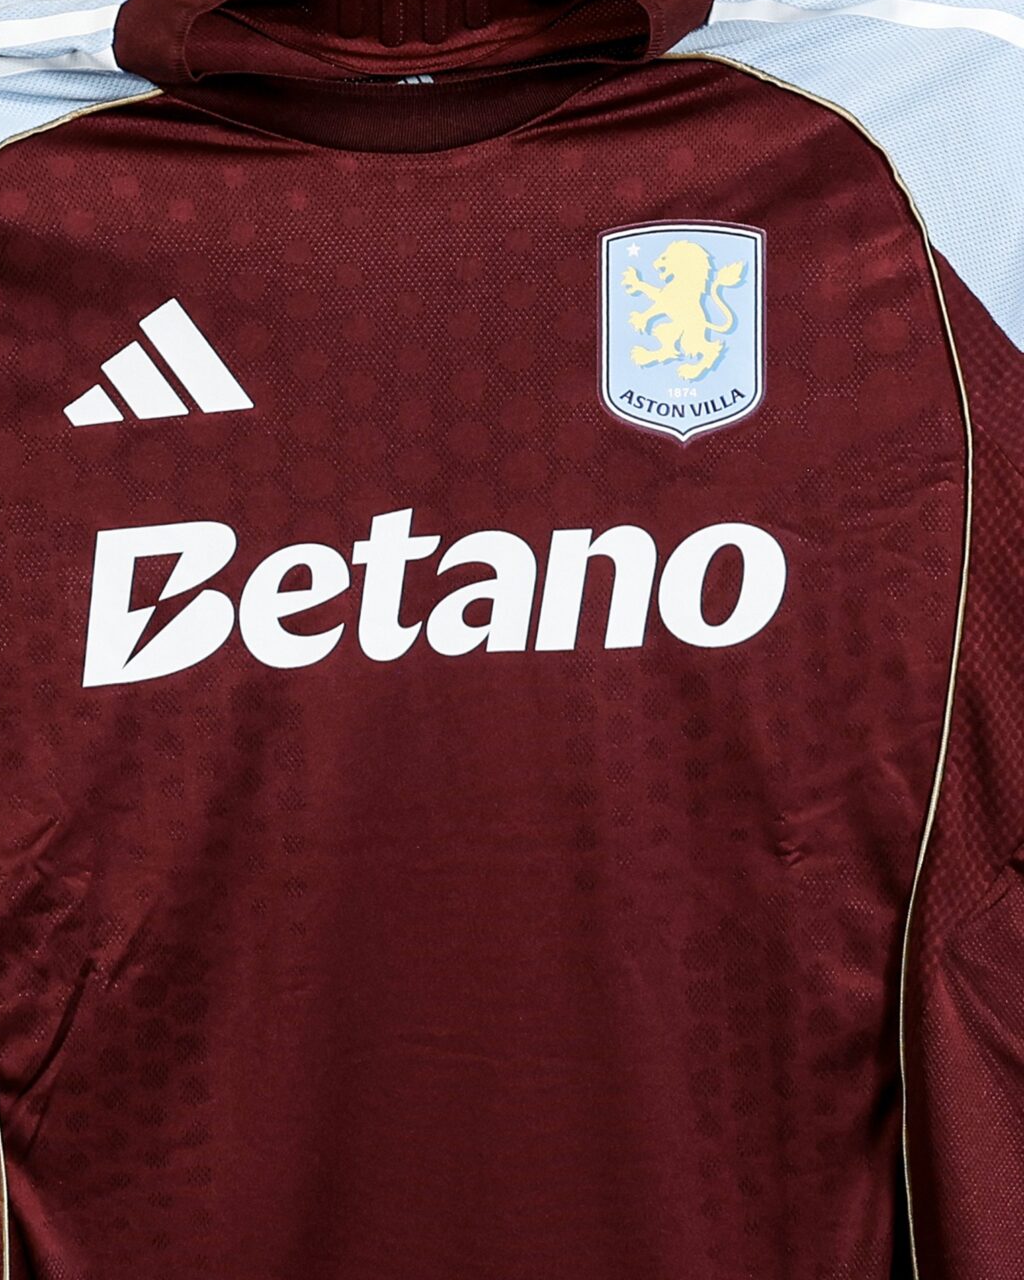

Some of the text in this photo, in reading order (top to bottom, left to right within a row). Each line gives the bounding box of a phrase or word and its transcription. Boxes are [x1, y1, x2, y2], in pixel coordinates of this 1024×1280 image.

[619, 388, 746, 418] ASTON VILLA
[668, 387, 698, 398] 1874
[82, 507, 787, 688] Betano
